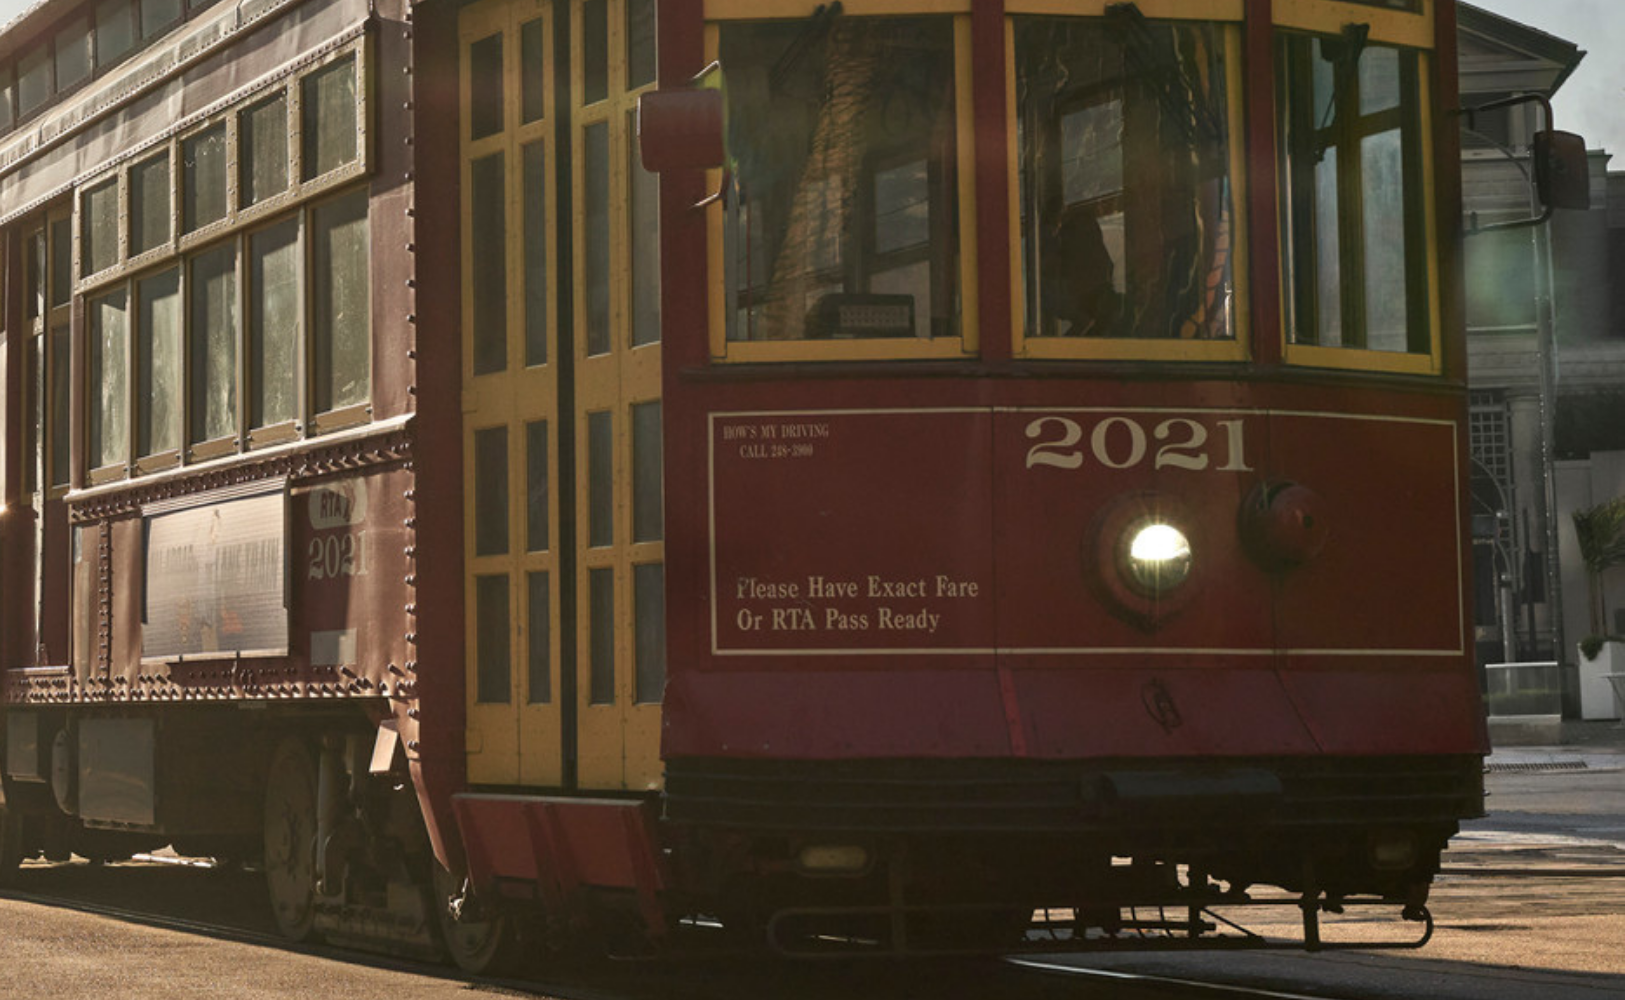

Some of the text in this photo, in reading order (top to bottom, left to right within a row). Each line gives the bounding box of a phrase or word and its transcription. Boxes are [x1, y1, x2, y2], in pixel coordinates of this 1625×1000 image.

[723, 423, 829, 439] HOW'S MY DRIVING
[1025, 416, 1255, 471] 2021
[739, 445, 768, 458] CALL
[319, 489, 342, 519] RTA
[308, 530, 369, 580] 2021
[736, 575, 980, 599] Please Have Exact Fare
[736, 607, 941, 632] Or RTA Pass Ready
